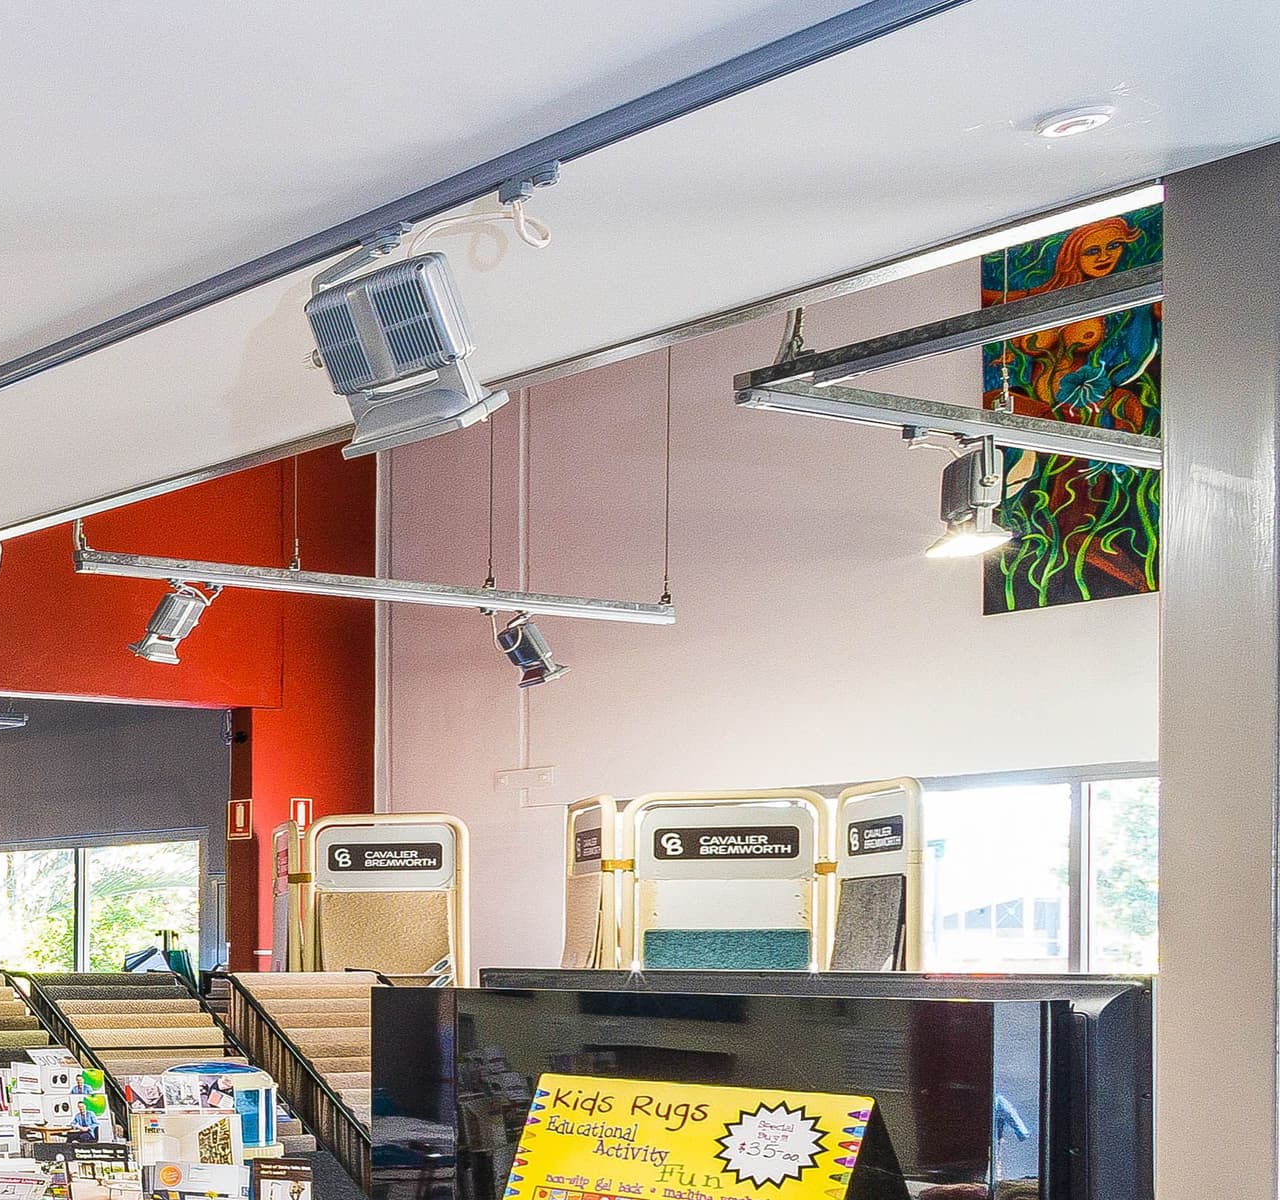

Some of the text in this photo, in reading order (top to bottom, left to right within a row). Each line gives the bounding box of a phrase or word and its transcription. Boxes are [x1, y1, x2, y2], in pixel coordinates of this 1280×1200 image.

[699, 835, 768, 845] CAVALIER
[699, 844, 791, 855] BREMWORTH
[365, 850, 418, 859] CAVALIER
[365, 858, 436, 867] BREMWORTH
[552, 1088, 710, 1132] Kids Rugs
[546, 1115, 638, 1142] Educational
[593, 1139, 671, 1167] Activity
[546, 1174, 589, 1189] non-slip
[595, 1179, 612, 1192] gel
[619, 1182, 644, 1195] back
[656, 1163, 725, 1190] Fun
